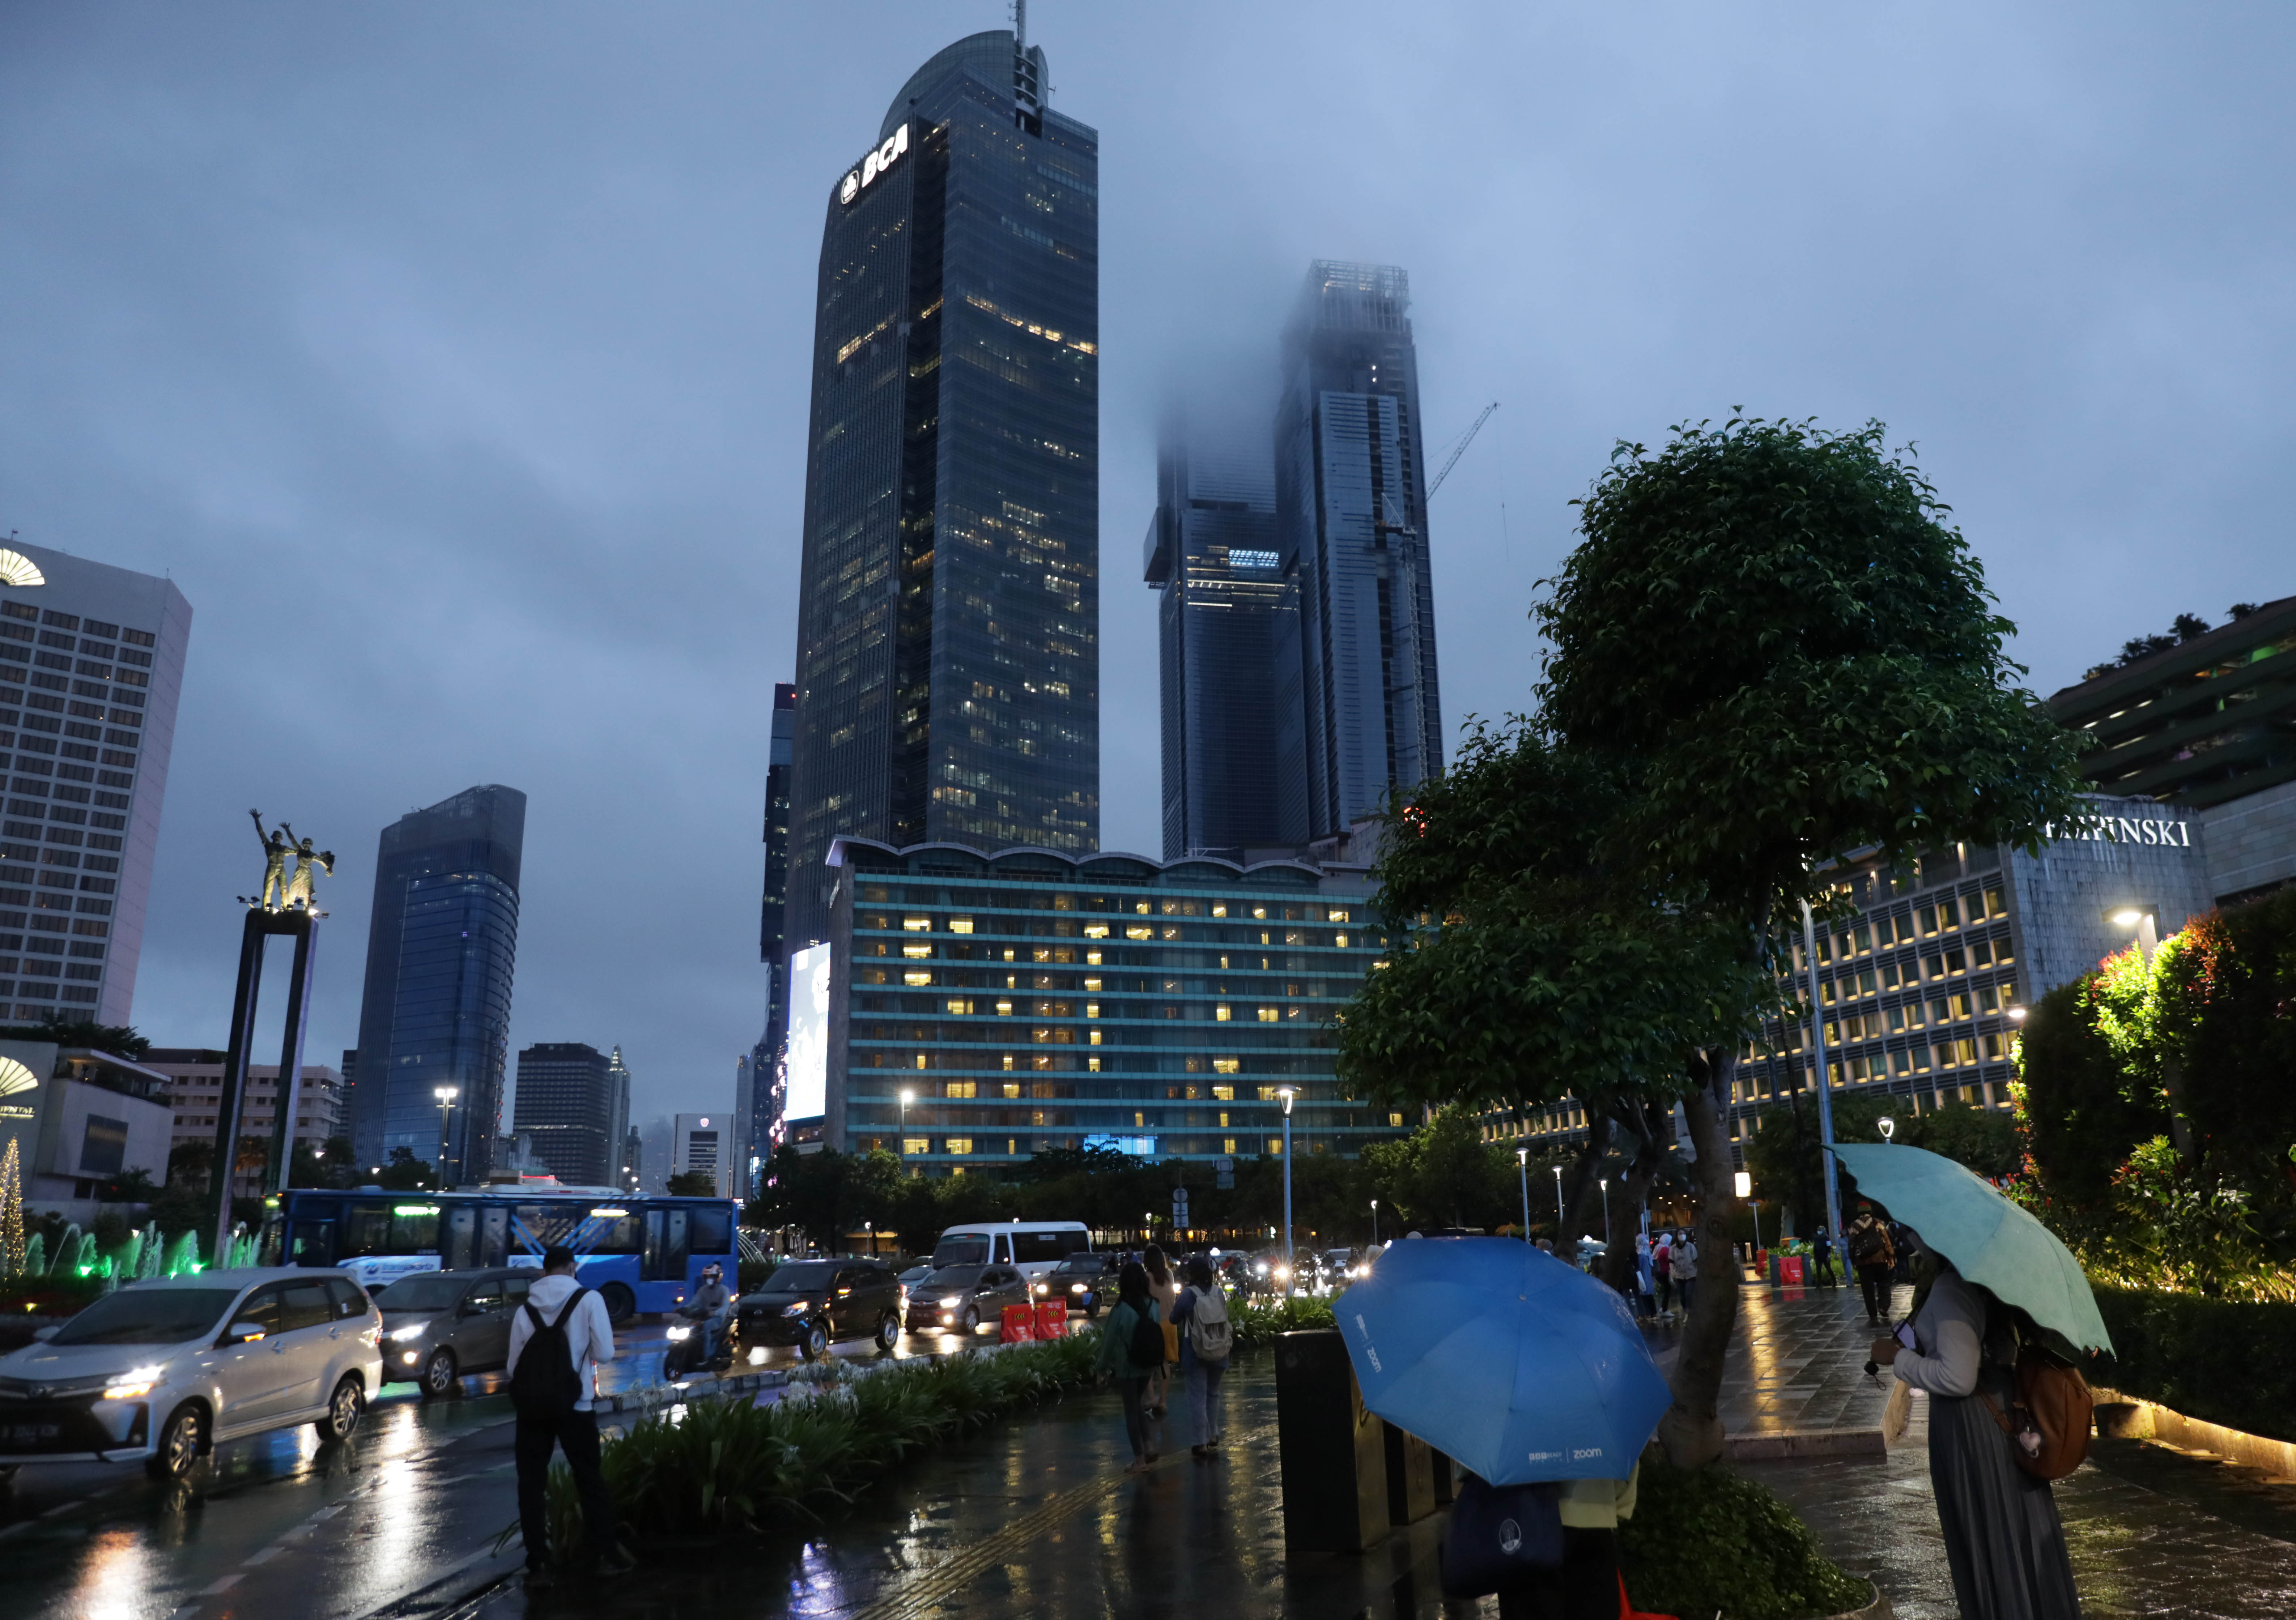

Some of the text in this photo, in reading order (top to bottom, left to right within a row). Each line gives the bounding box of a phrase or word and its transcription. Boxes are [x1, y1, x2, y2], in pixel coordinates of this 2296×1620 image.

[862, 123, 908, 188] BCA
[2027, 814, 2190, 847] EMPINSKI
[1368, 1346, 1382, 1373] zoom
[1573, 1448, 1602, 1459] zoom
